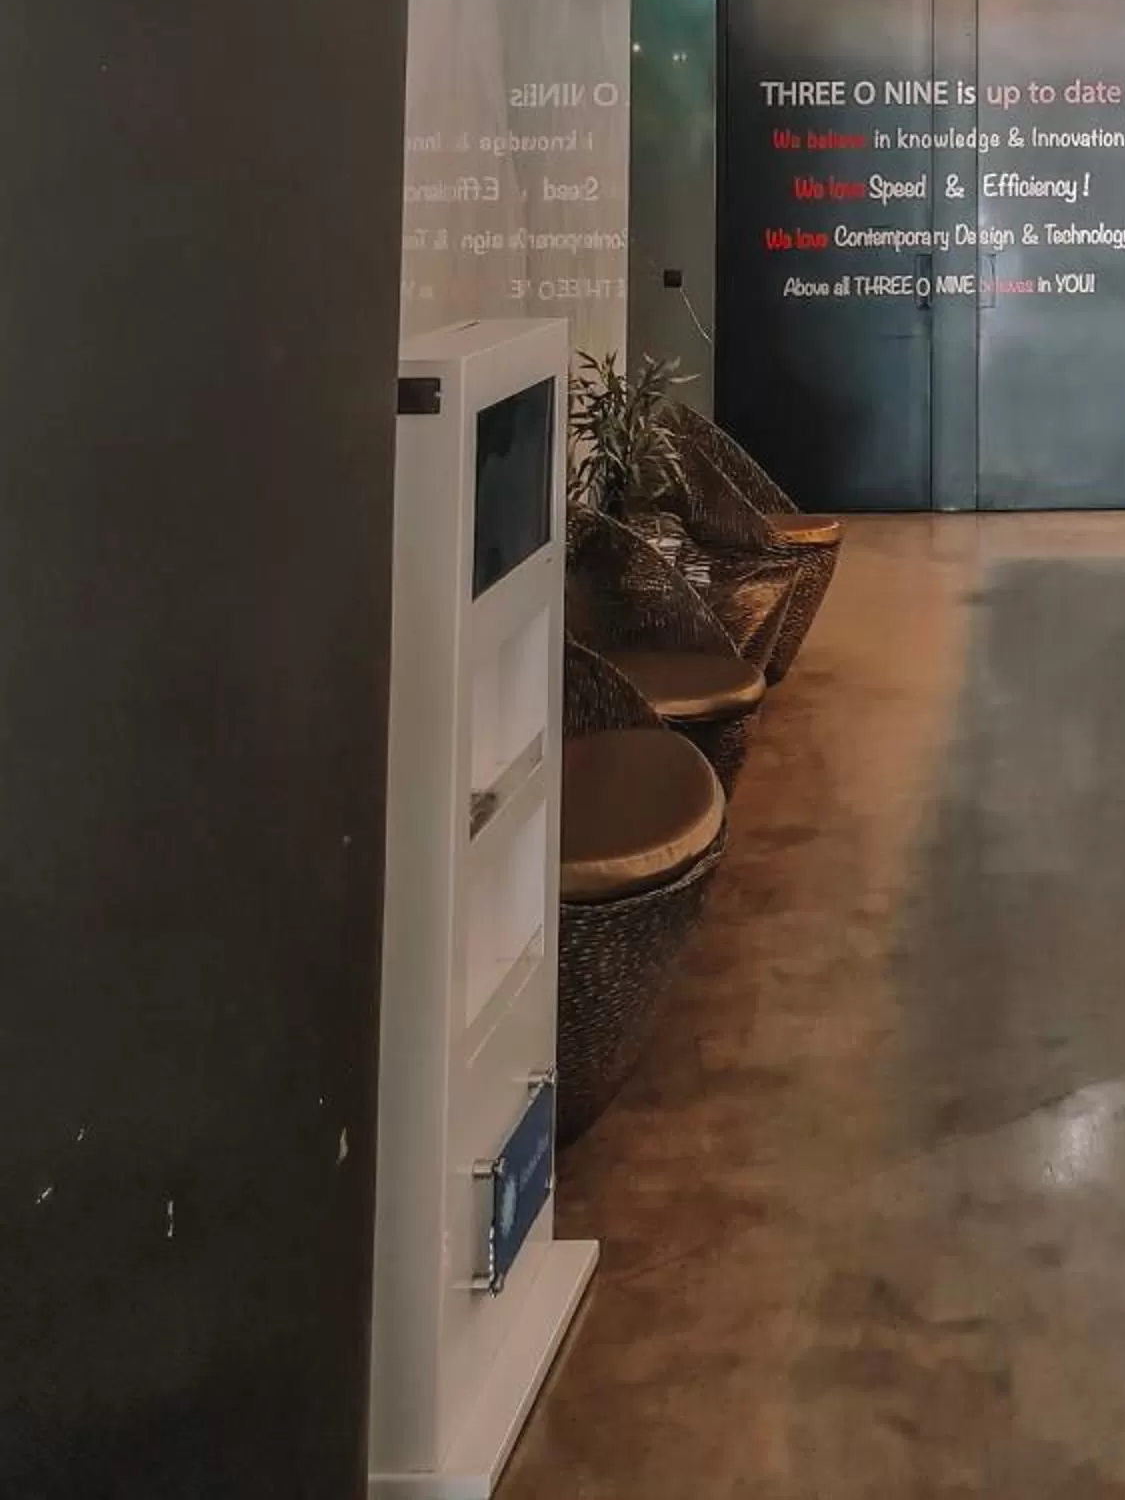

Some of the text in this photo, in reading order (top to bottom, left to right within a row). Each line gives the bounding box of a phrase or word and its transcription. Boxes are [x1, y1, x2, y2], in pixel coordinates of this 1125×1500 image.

[760, 81, 846, 106] THREE
[854, 81, 876, 105] O
[884, 80, 949, 105] NINE
[957, 80, 977, 105] is
[986, 84, 1021, 110] up
[1027, 81, 1056, 104] to
[1064, 78, 1122, 104] date
[874, 128, 891, 149] in
[897, 127, 1001, 153] knowledge
[1007, 126, 1026, 148] &
[1032, 126, 1125, 148] Innovation
[869, 173, 927, 206] Speed
[945, 173, 965, 198] &
[983, 173, 1078, 203] Efficiency
[834, 225, 950, 252] Contemporary
[955, 223, 1015, 250] Design
[1021, 223, 1040, 245] &
[783, 276, 830, 297] Above
[833, 276, 851, 296] all
[854, 275, 914, 296] THREE
[916, 277, 931, 297] O
[935, 274, 977, 295] NINE
[1037, 274, 1051, 294] in
